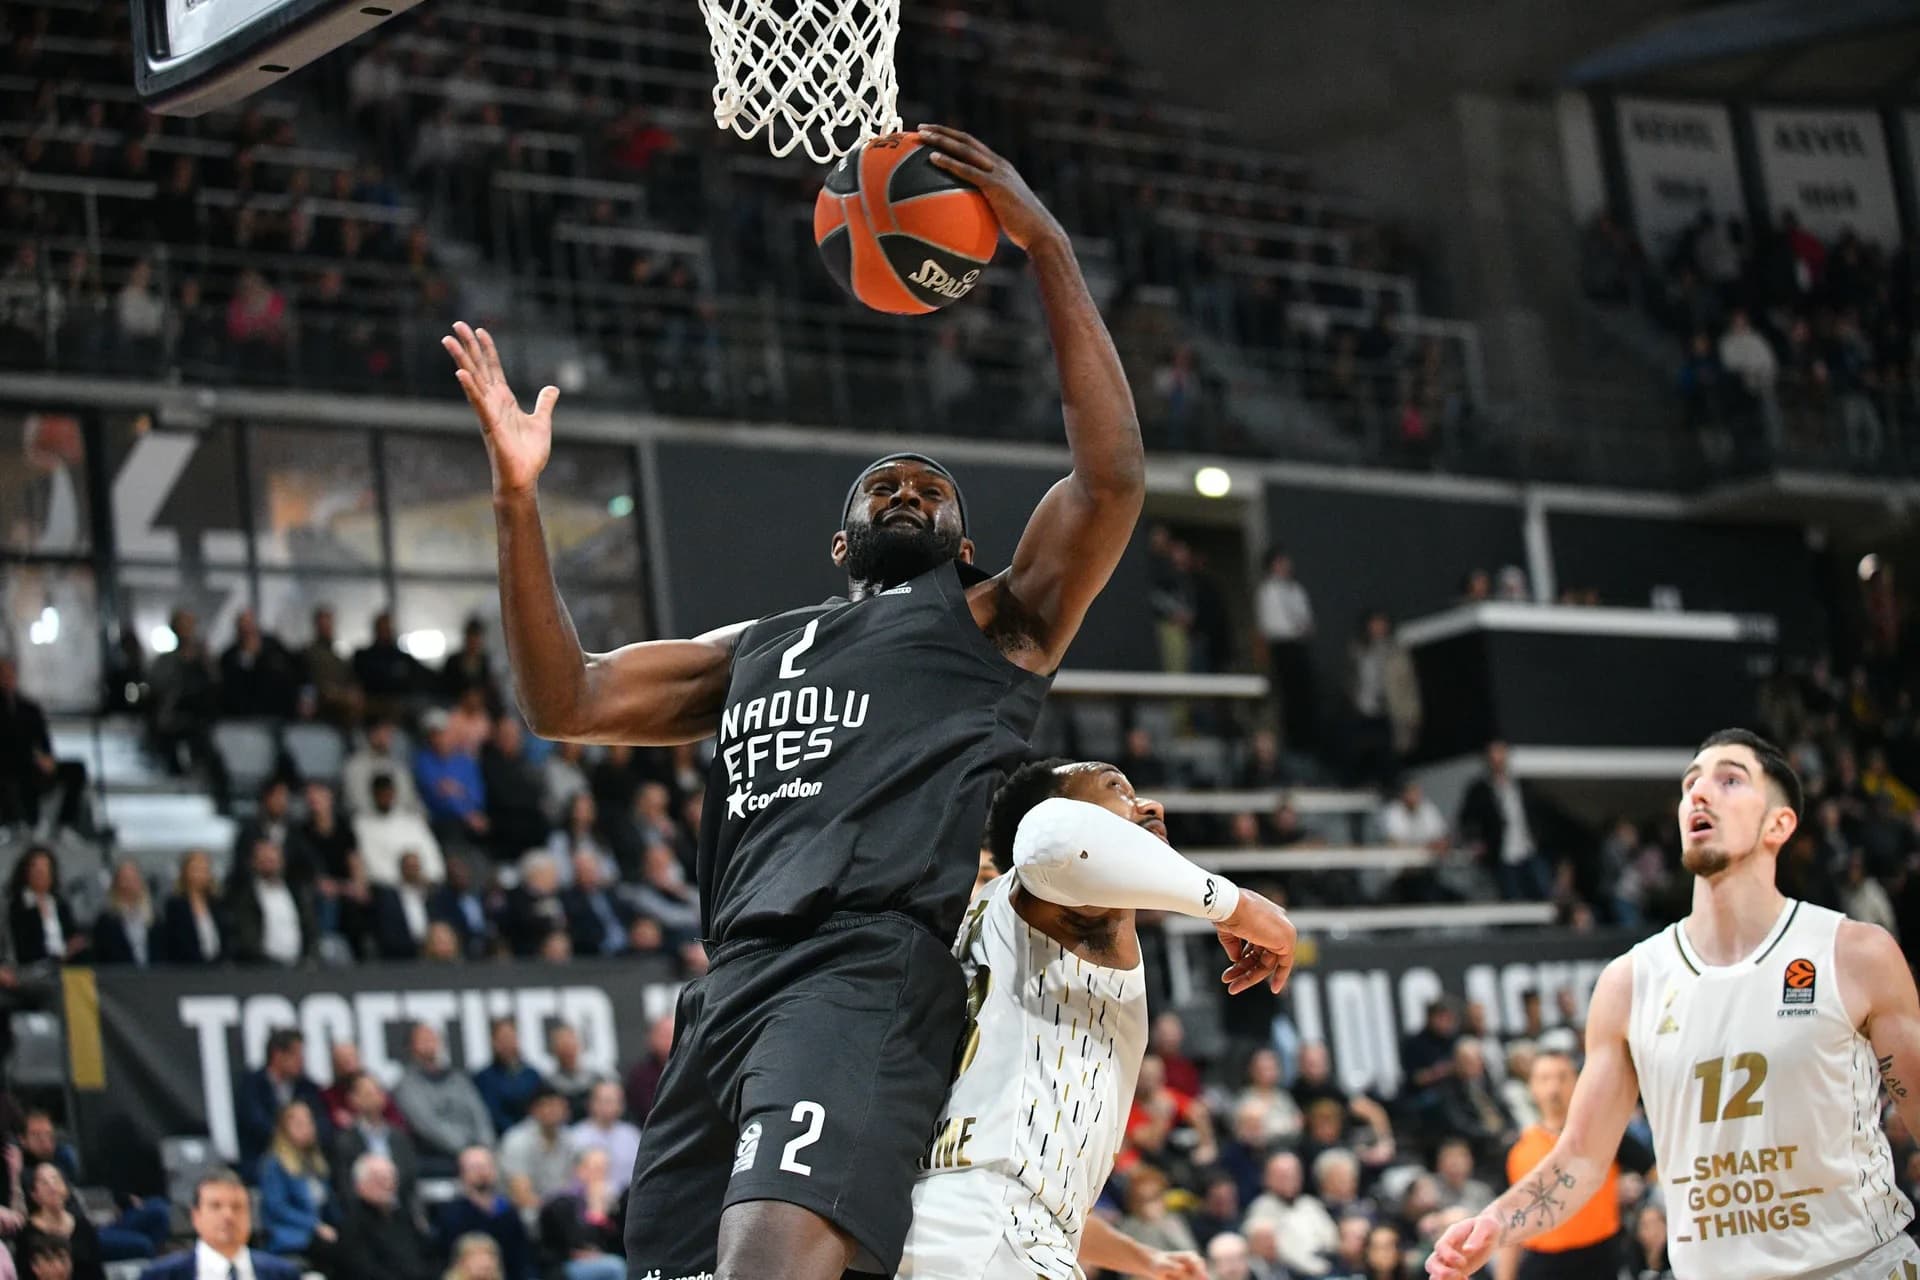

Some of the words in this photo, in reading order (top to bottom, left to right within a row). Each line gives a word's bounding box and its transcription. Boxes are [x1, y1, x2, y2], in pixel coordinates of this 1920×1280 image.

[779, 619, 819, 679] 2
[713, 686, 870, 758] NADOLU
[723, 726, 836, 785] EFES
[1694, 1052, 1768, 1124] 12
[779, 1100, 825, 1177] 2
[1693, 1145, 1798, 1181] SMART
[1688, 1178, 1775, 1212] GOOD
[1693, 1202, 1811, 1241] THINGS
